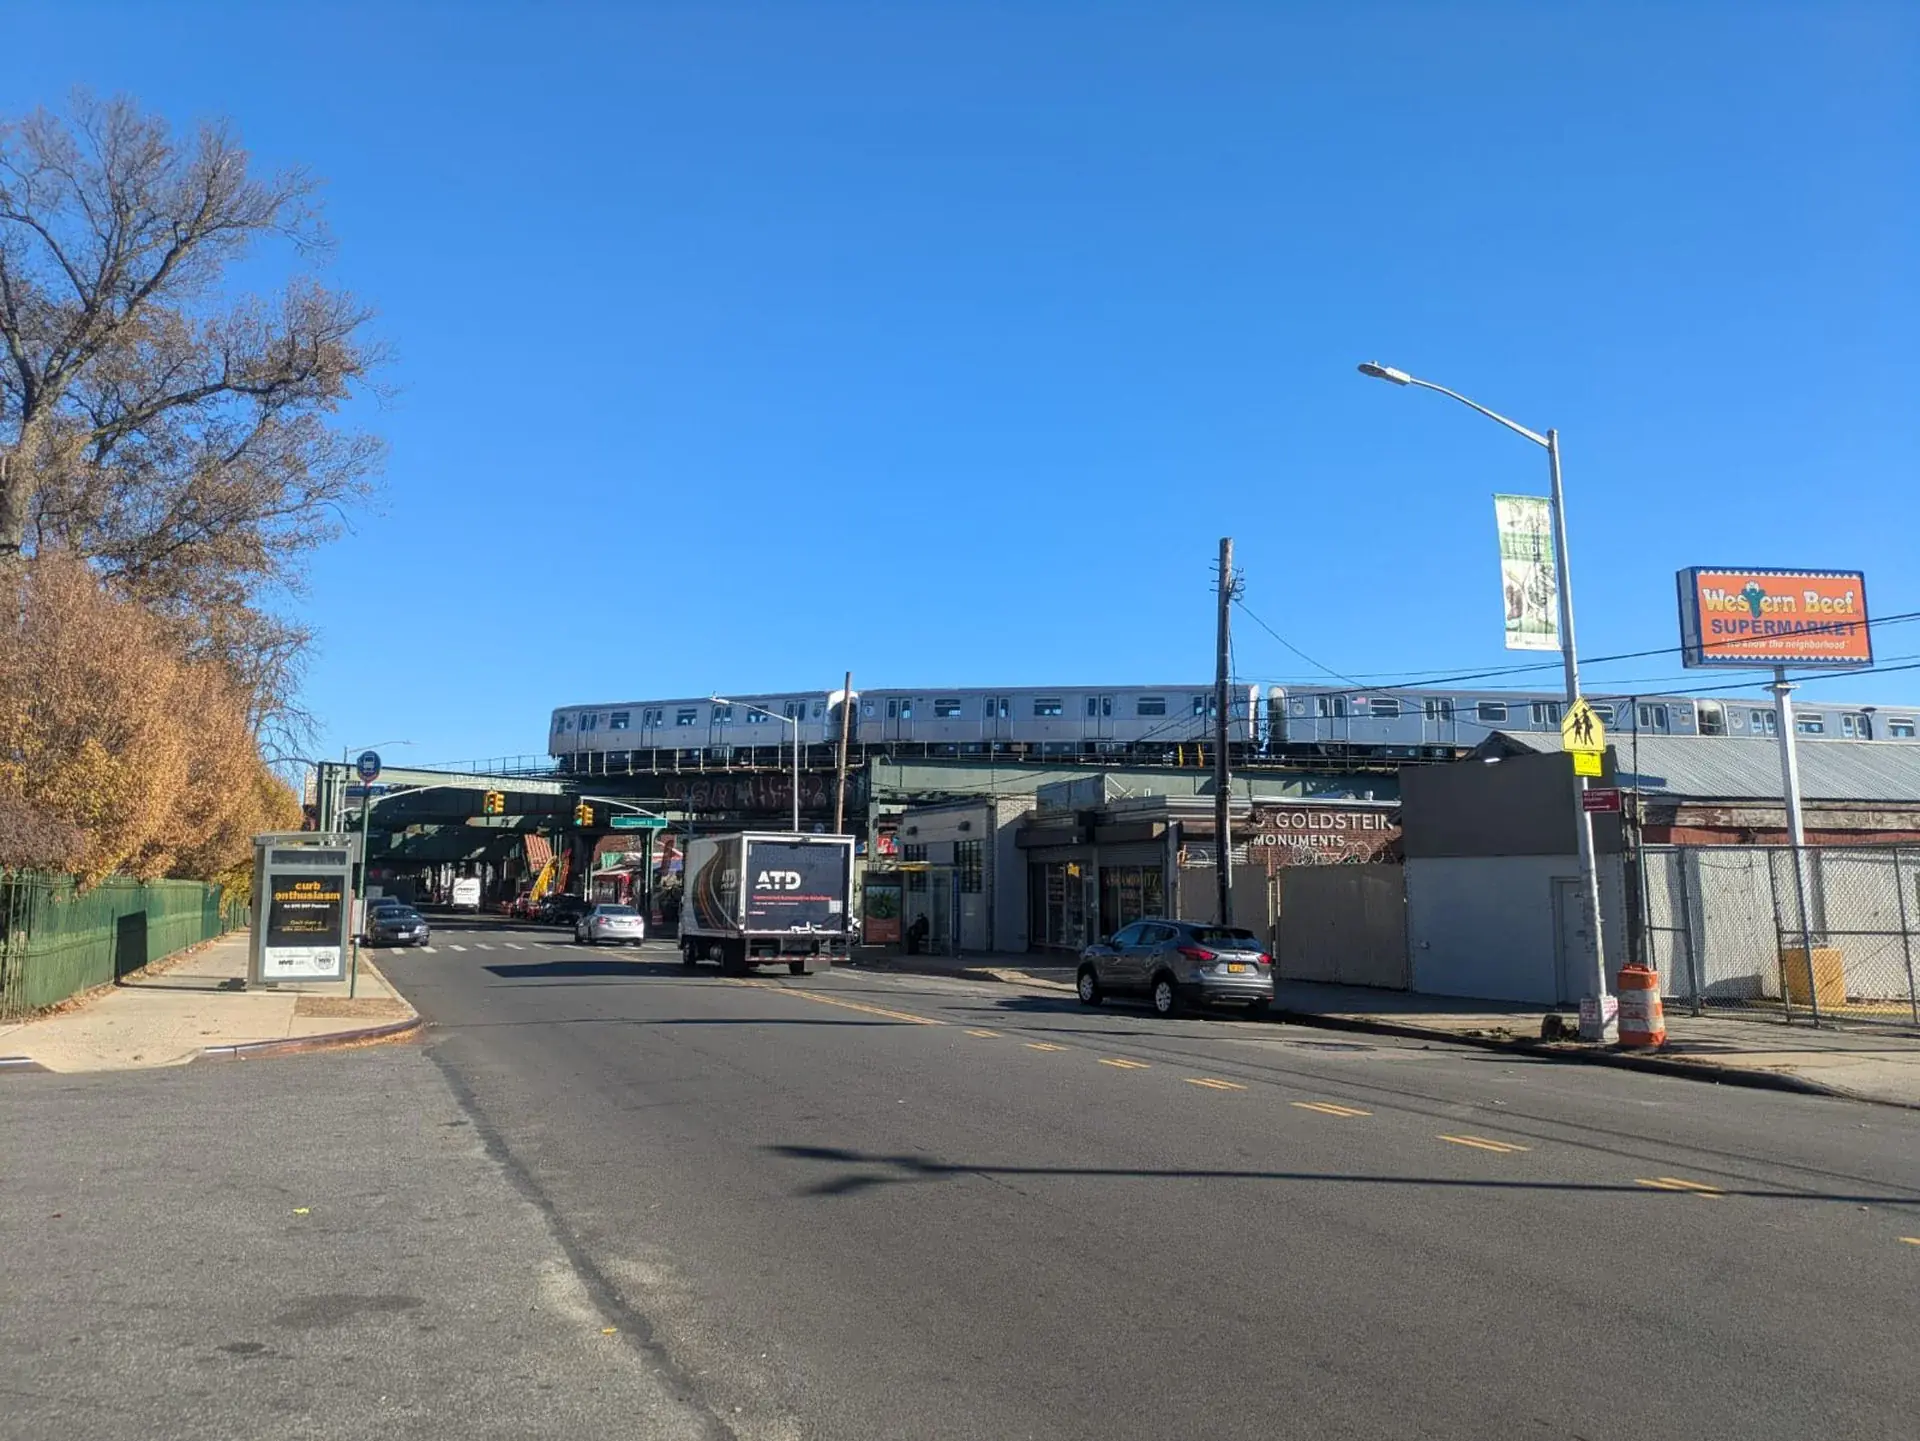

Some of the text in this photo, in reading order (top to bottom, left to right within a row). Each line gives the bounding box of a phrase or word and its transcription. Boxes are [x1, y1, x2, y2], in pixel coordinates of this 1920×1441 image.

[1702, 586, 1854, 616] Western Beef
[1711, 619, 1857, 637] SUPERMARKET
[1769, 639, 1784, 649] the
[1253, 833, 1345, 847] MONUMENTS
[295, 881, 321, 890] curb
[755, 870, 802, 890] ATD
[275, 891, 340, 901] enthusiasm
